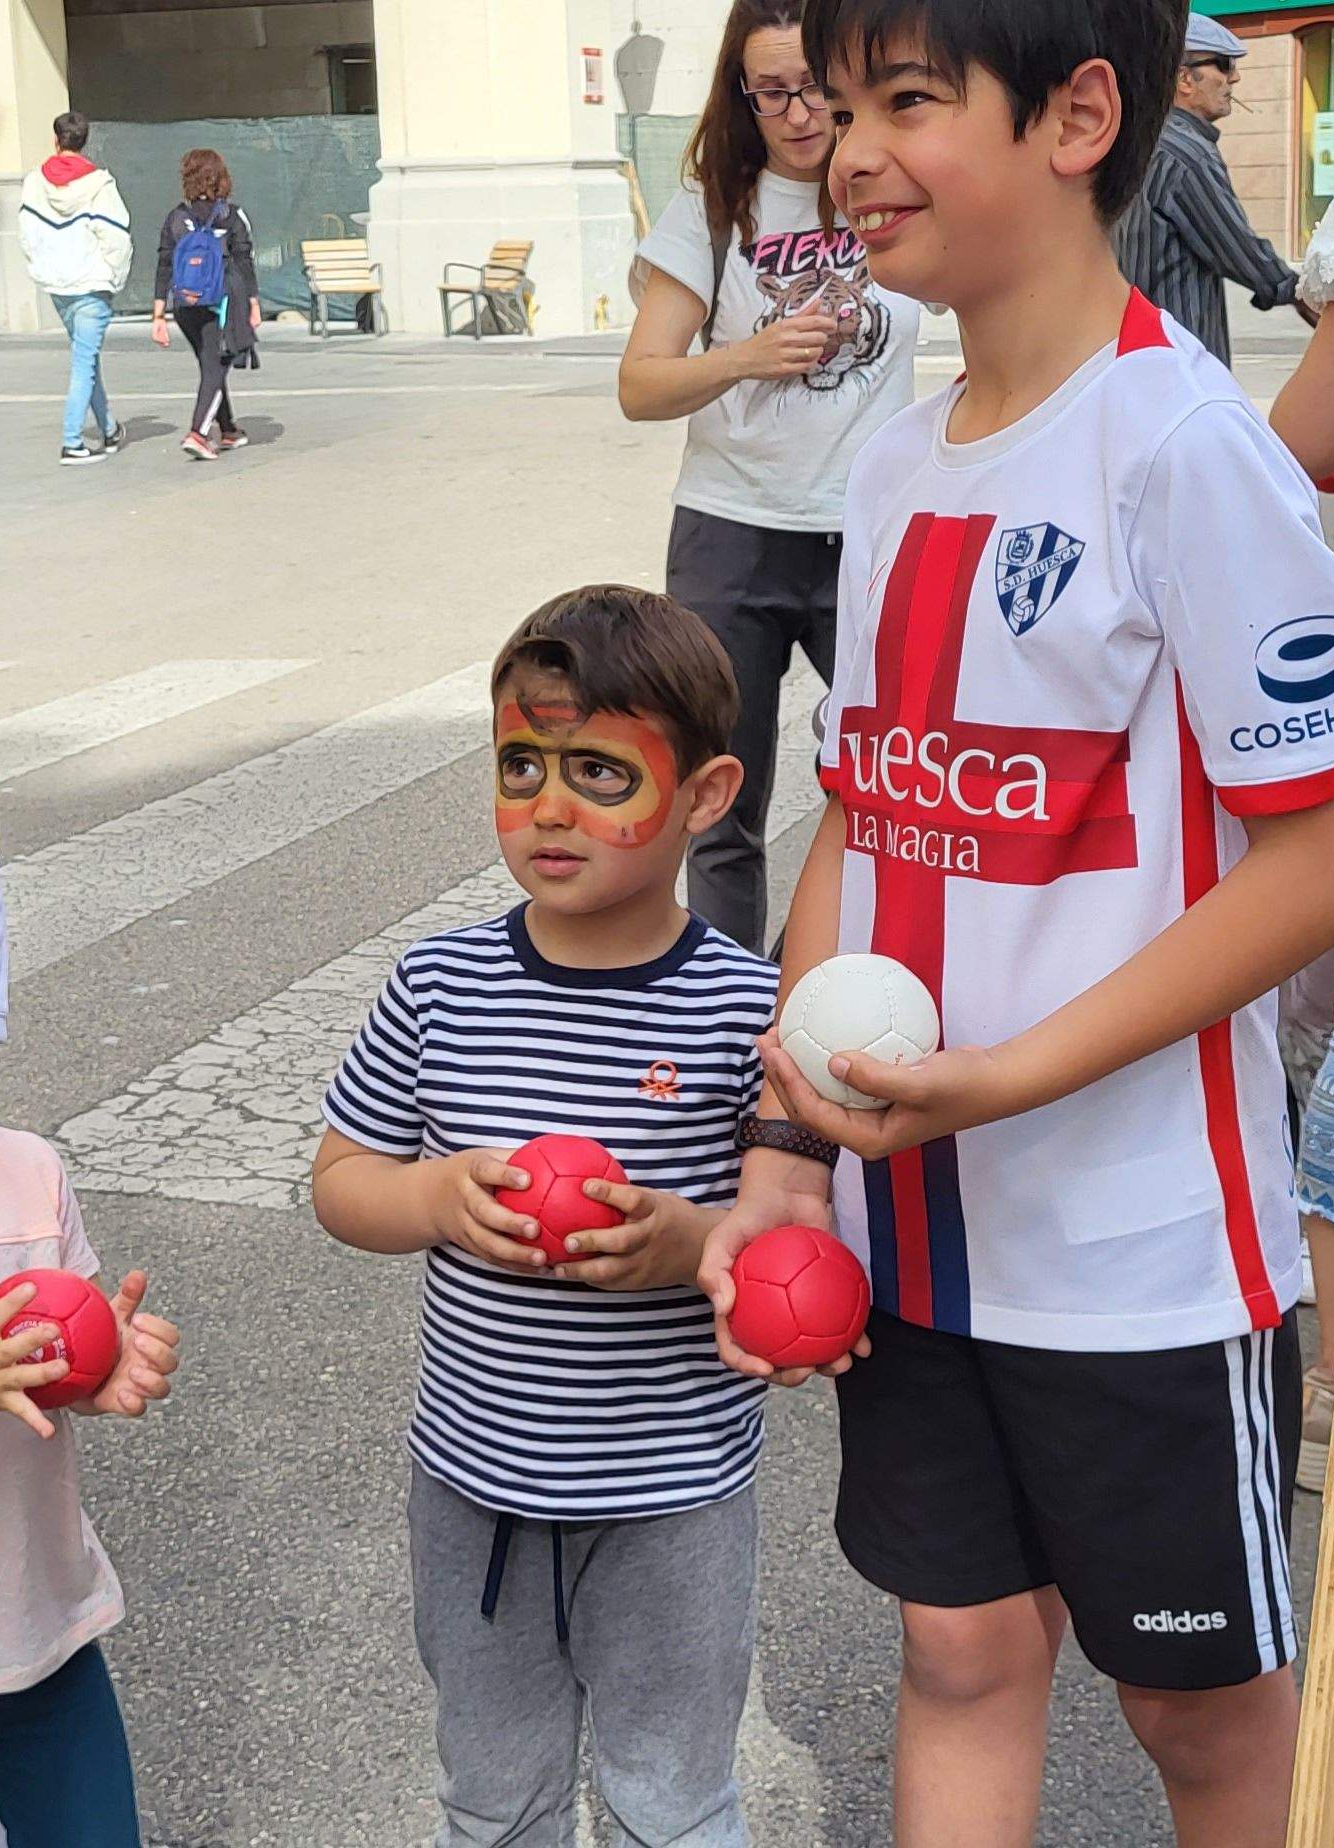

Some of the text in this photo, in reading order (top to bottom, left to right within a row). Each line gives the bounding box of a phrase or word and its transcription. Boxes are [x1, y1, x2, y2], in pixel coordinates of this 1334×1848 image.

[1003, 547, 1077, 591] S.D. HUESCA
[842, 726, 1051, 821] uesca
[1133, 1610, 1228, 1633] adidas
